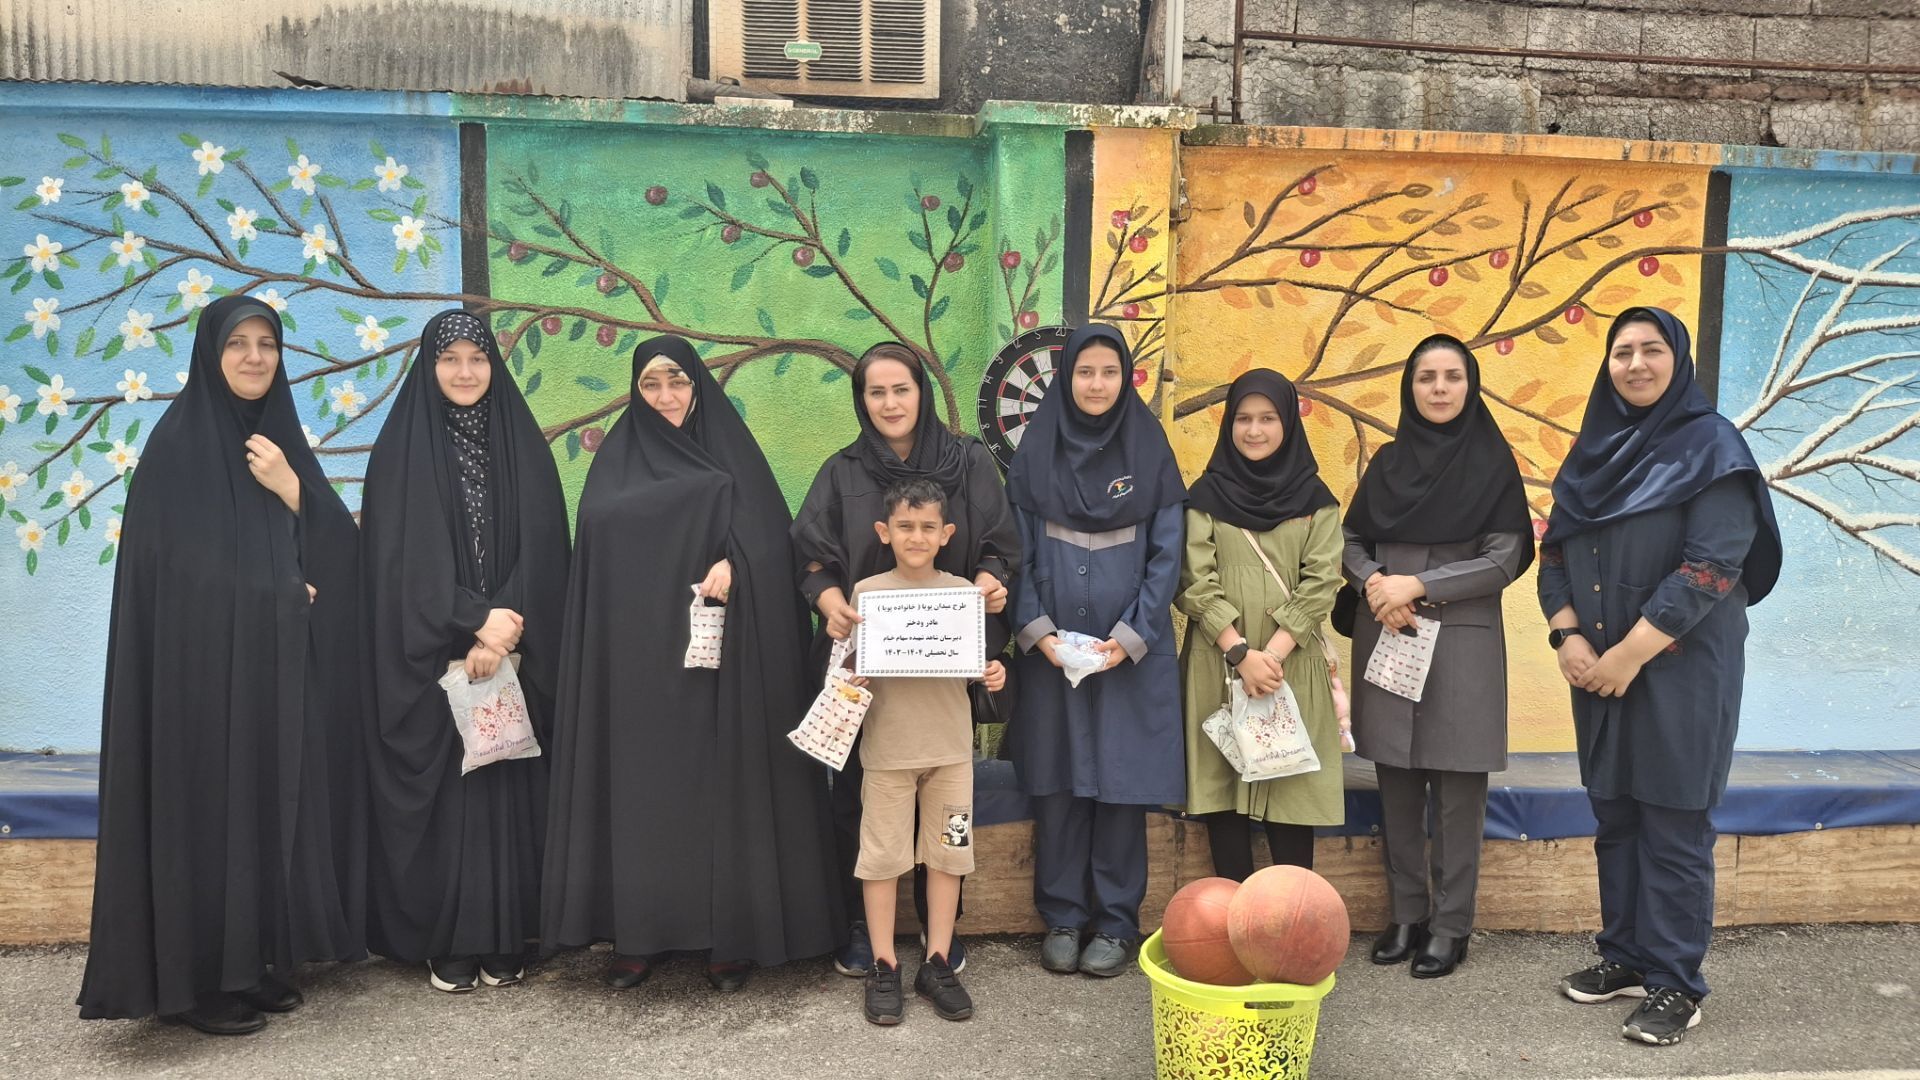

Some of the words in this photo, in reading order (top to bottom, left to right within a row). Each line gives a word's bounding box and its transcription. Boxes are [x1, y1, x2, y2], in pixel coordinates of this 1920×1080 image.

[1034, 329, 1042, 340] 5
[1054, 326, 1067, 337] 20
[1012, 337, 1023, 349] 12
[983, 374, 994, 385] 14
[981, 422, 991, 430] 8
[893, 603, 916, 613] خانواده
[933, 602, 951, 611] میدان
[952, 601, 967, 611] طرح
[925, 619, 939, 628] مادر
[947, 649, 959, 657] سال
[505, 735, 531, 748] Dreams
